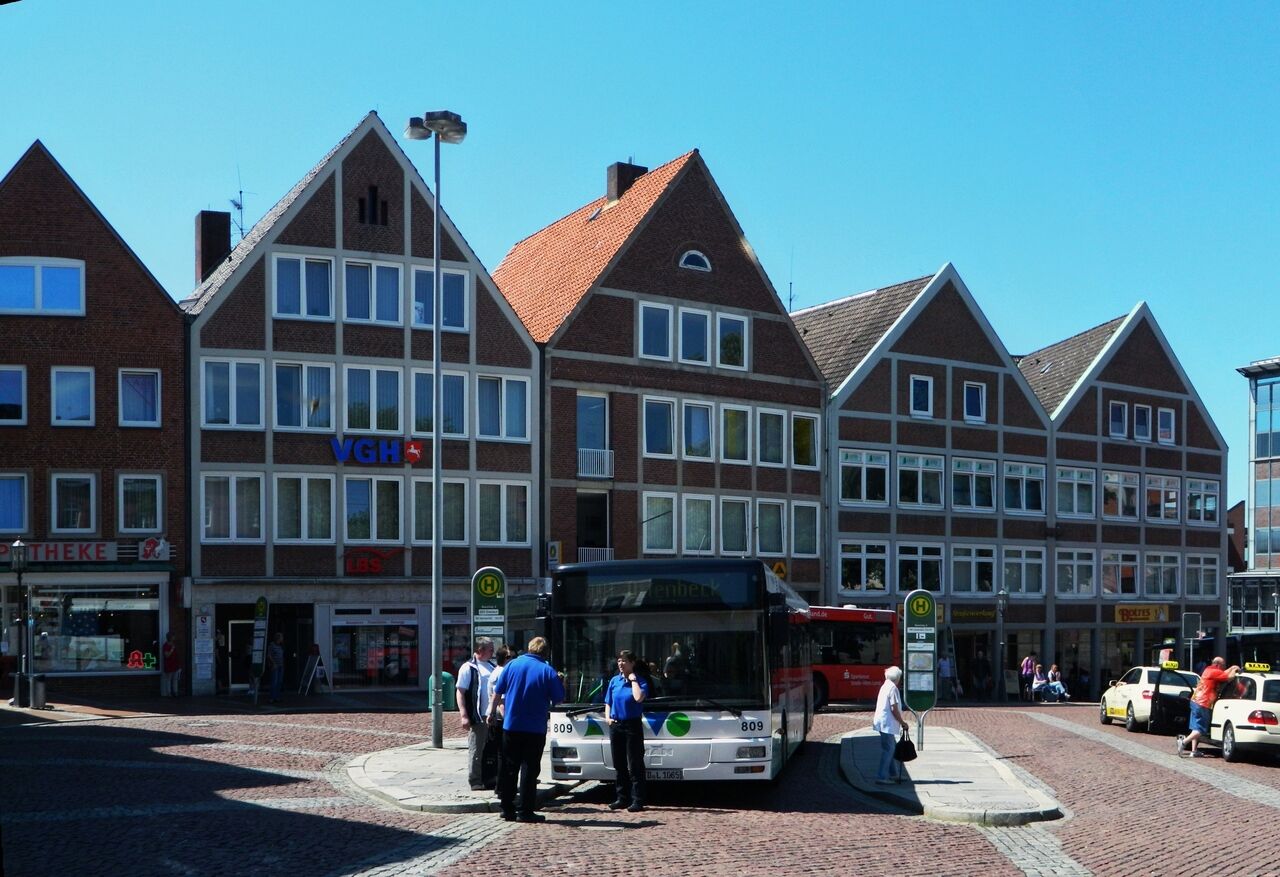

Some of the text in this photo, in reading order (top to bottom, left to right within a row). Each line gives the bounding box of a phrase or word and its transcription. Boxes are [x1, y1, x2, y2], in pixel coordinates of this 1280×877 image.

[330, 438, 400, 464] VGH
[0, 543, 107, 561] PTHEKE
[346, 557, 384, 576] LBS
[553, 723, 573, 733] 809
[741, 721, 764, 731] 809
